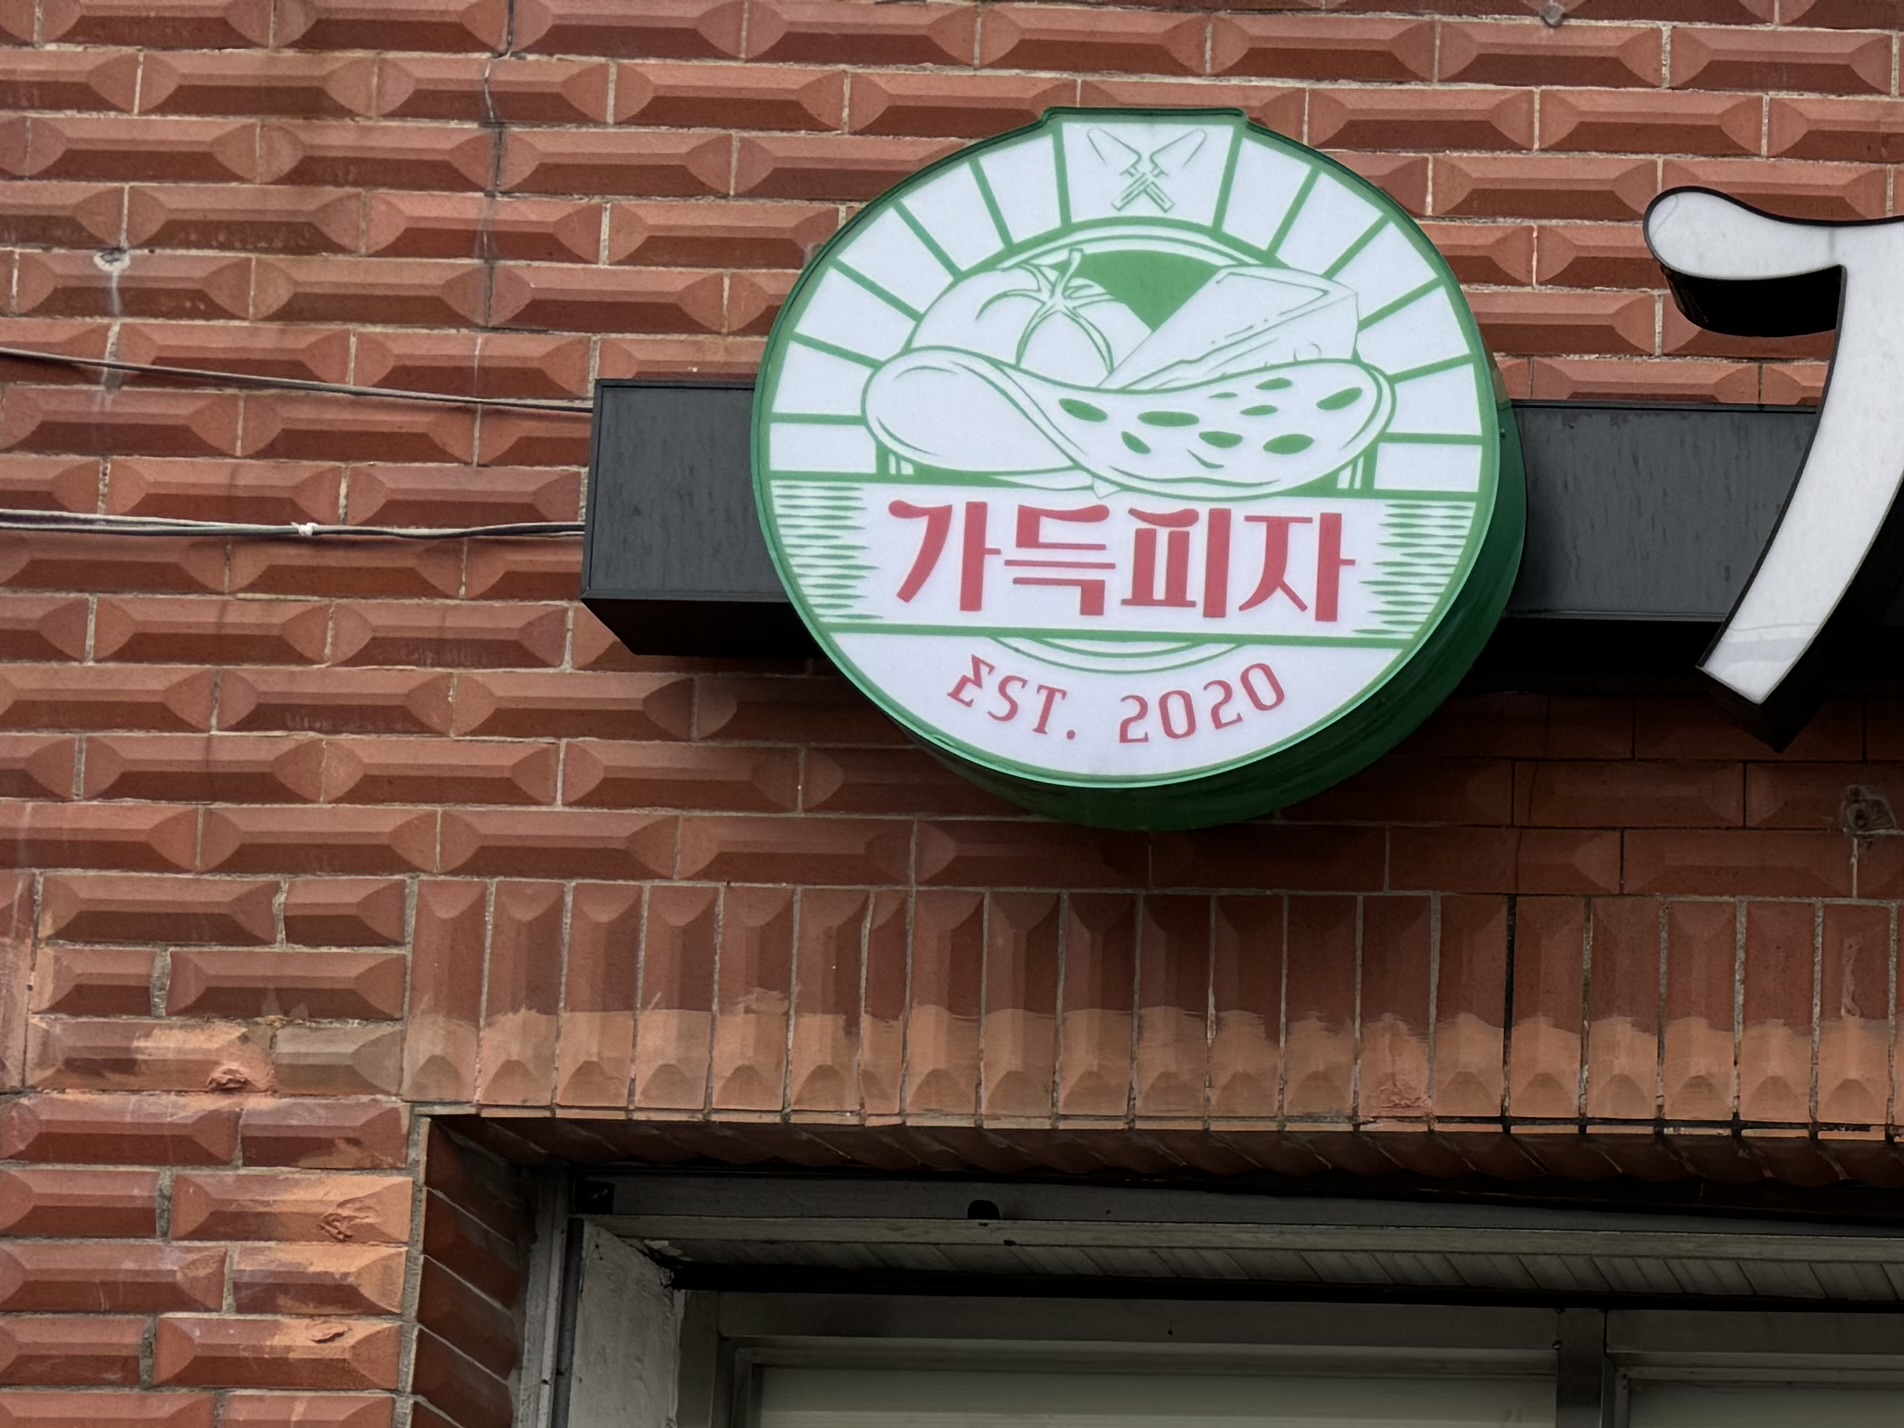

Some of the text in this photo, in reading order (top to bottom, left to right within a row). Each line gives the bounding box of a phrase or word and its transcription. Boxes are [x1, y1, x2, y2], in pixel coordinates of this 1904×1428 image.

[888, 499, 1356, 622] 가득피자
[947, 654, 1286, 745] EST. 2020
